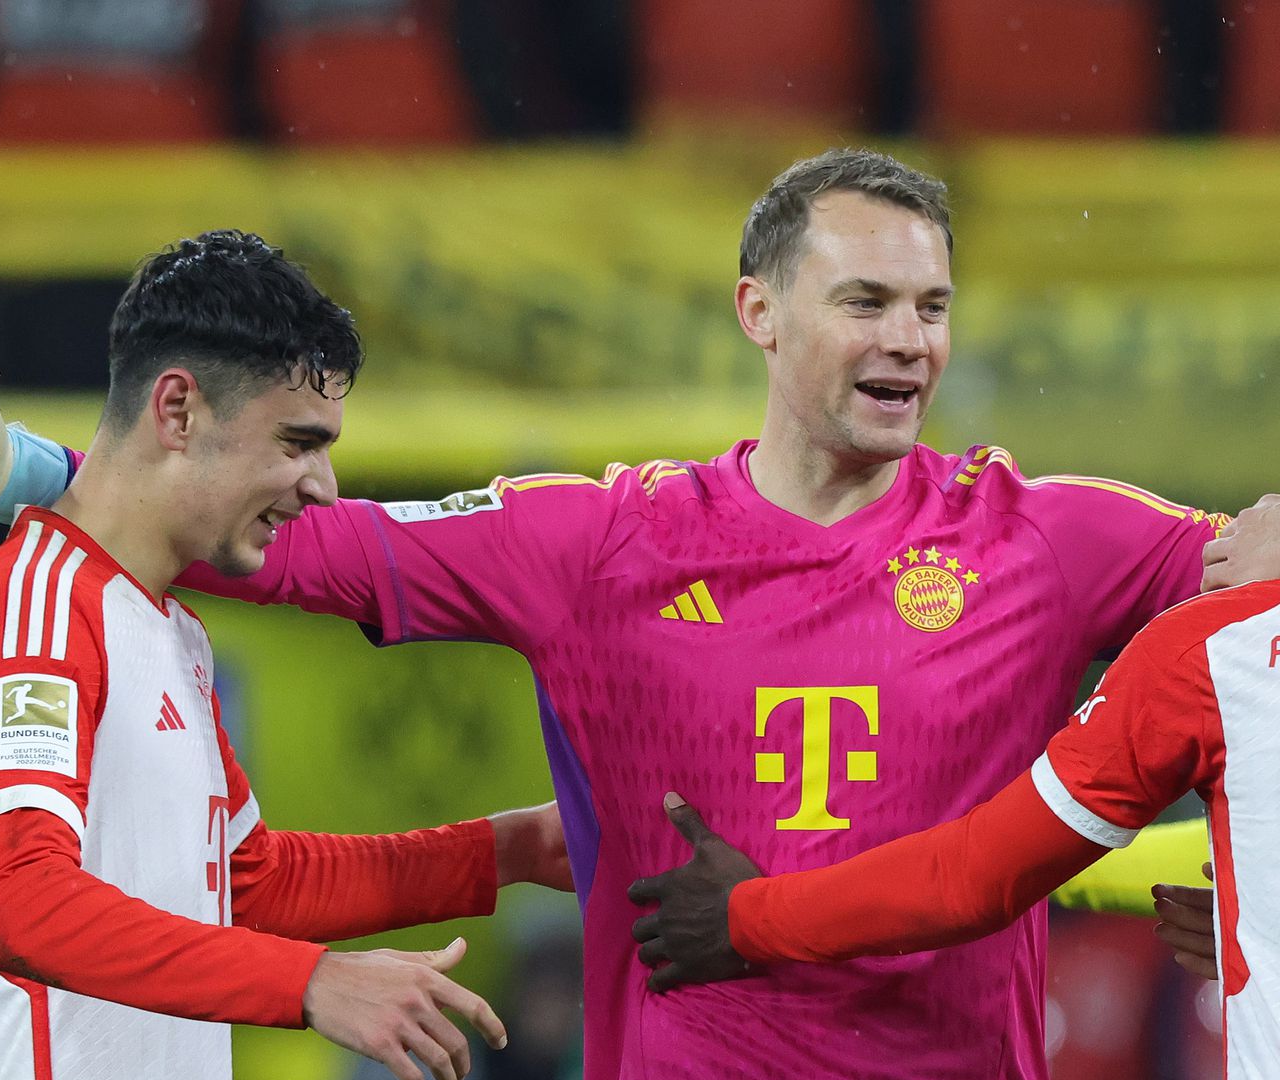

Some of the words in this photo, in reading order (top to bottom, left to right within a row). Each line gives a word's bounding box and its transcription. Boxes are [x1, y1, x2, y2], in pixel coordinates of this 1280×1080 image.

[901, 577, 915, 592] FC
[915, 570, 958, 595] BAYERN
[1, 729, 69, 742] BUNDESLIGA
[13, 747, 58, 755] DEUTSCHER
[0, 753, 70, 764] FUSSBALLMEISTER
